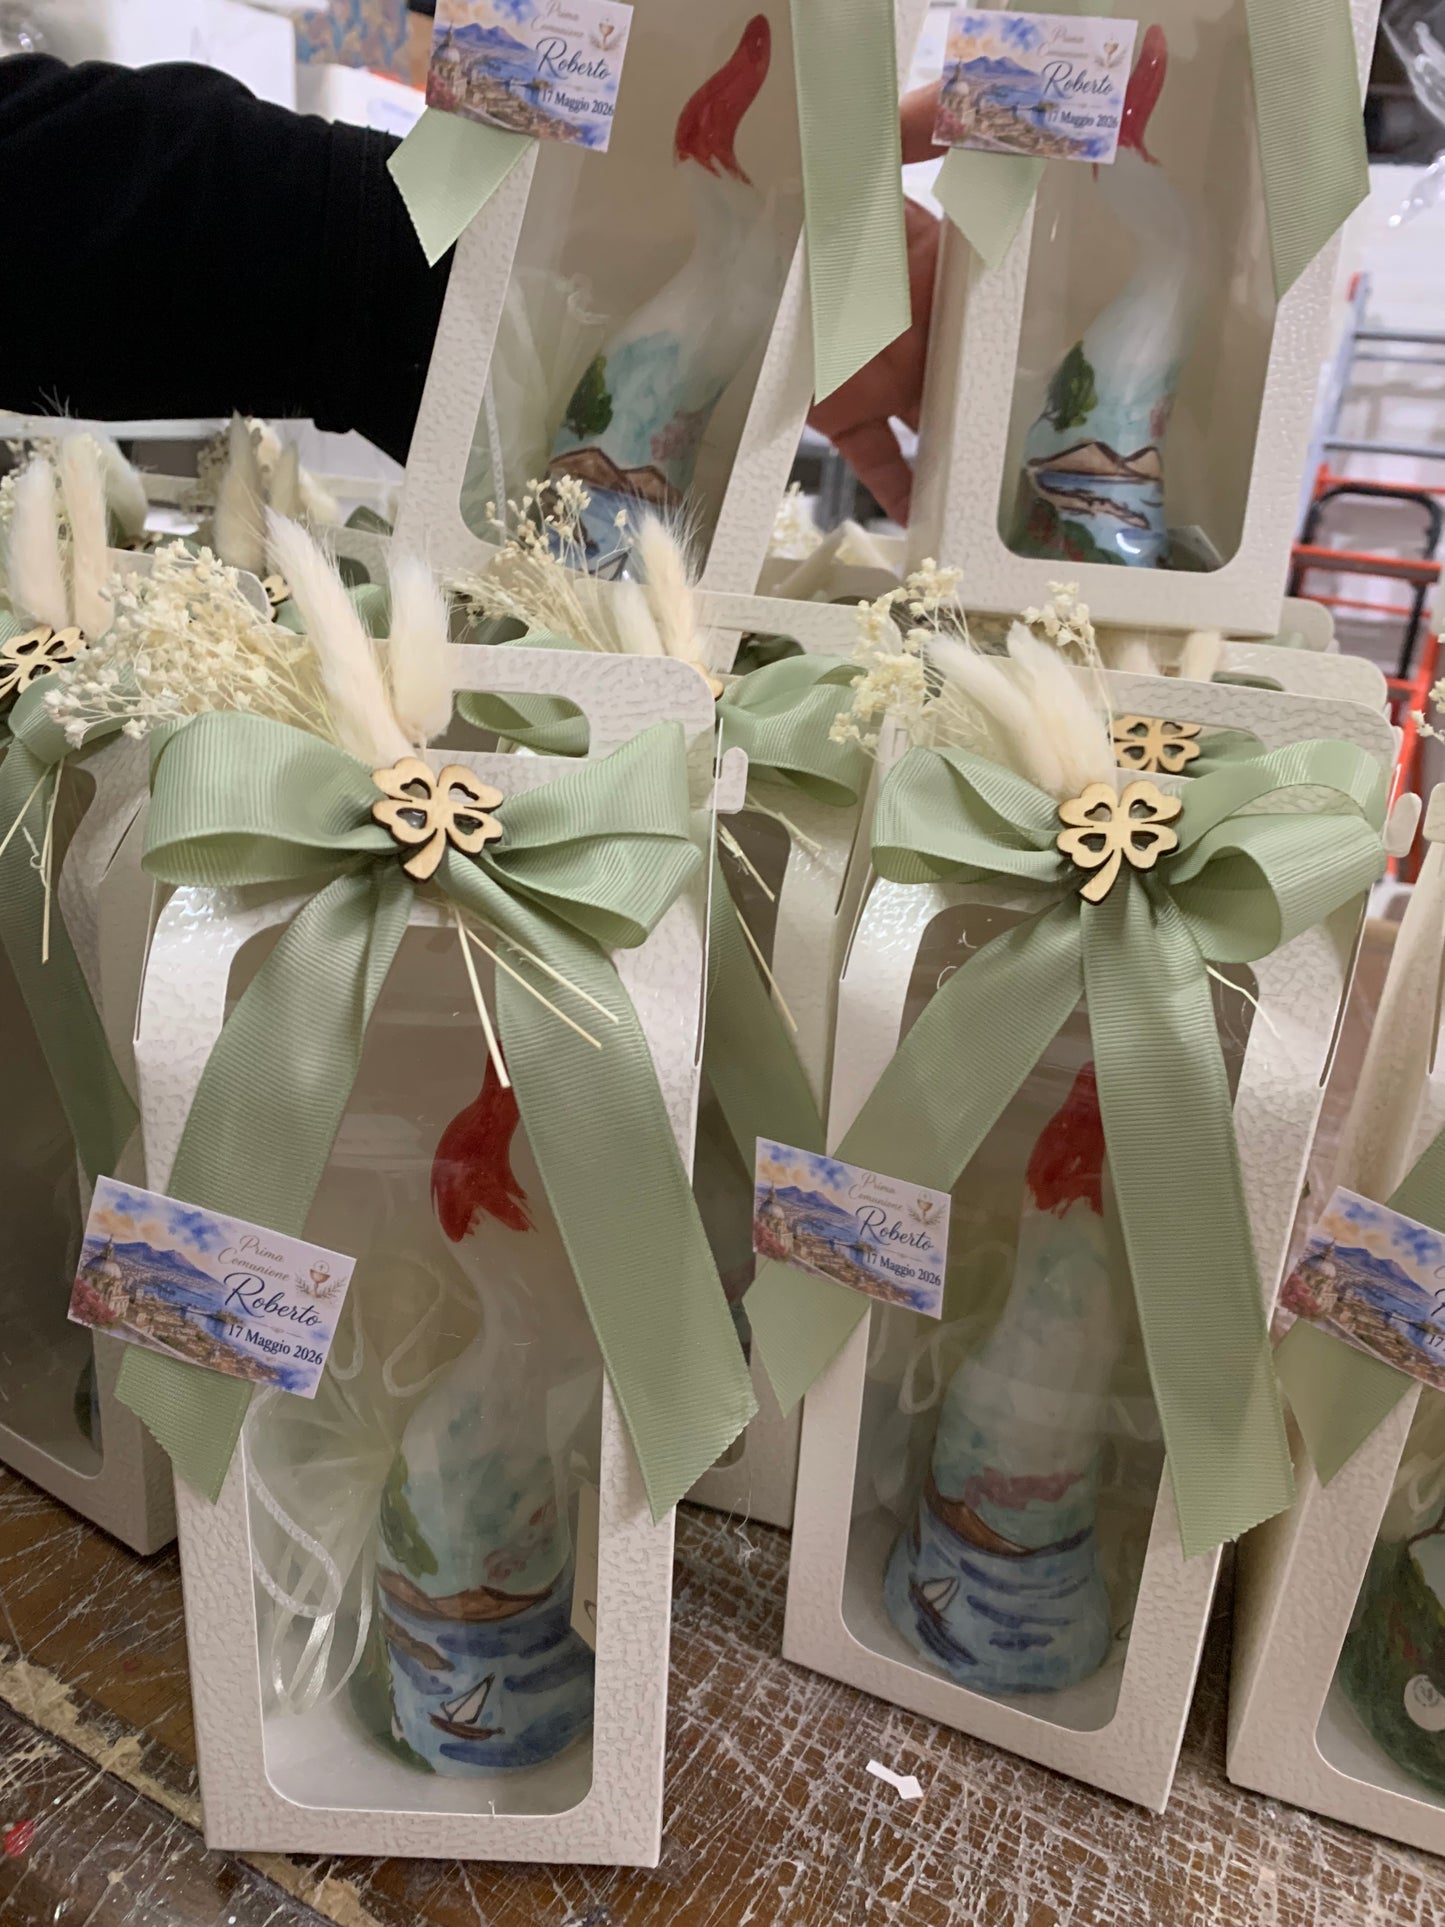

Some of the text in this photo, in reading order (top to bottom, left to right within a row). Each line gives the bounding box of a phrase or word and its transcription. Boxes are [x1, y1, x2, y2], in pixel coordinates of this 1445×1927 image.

[536, 37, 612, 80] Roberto
[1041, 61, 1114, 99] Roberto
[542, 88, 615, 117] 17 Maggio 2026
[1060, 110, 1094, 129] Maggio
[855, 1205, 934, 1251] Roberto
[217, 1247, 290, 1282] Comunione
[239, 1234, 284, 1263] Prima
[865, 1251, 941, 1287] 17 Maggio 2026
[223, 1271, 323, 1327] Roberto
[228, 1323, 323, 1366] 17 Maggio 2026
